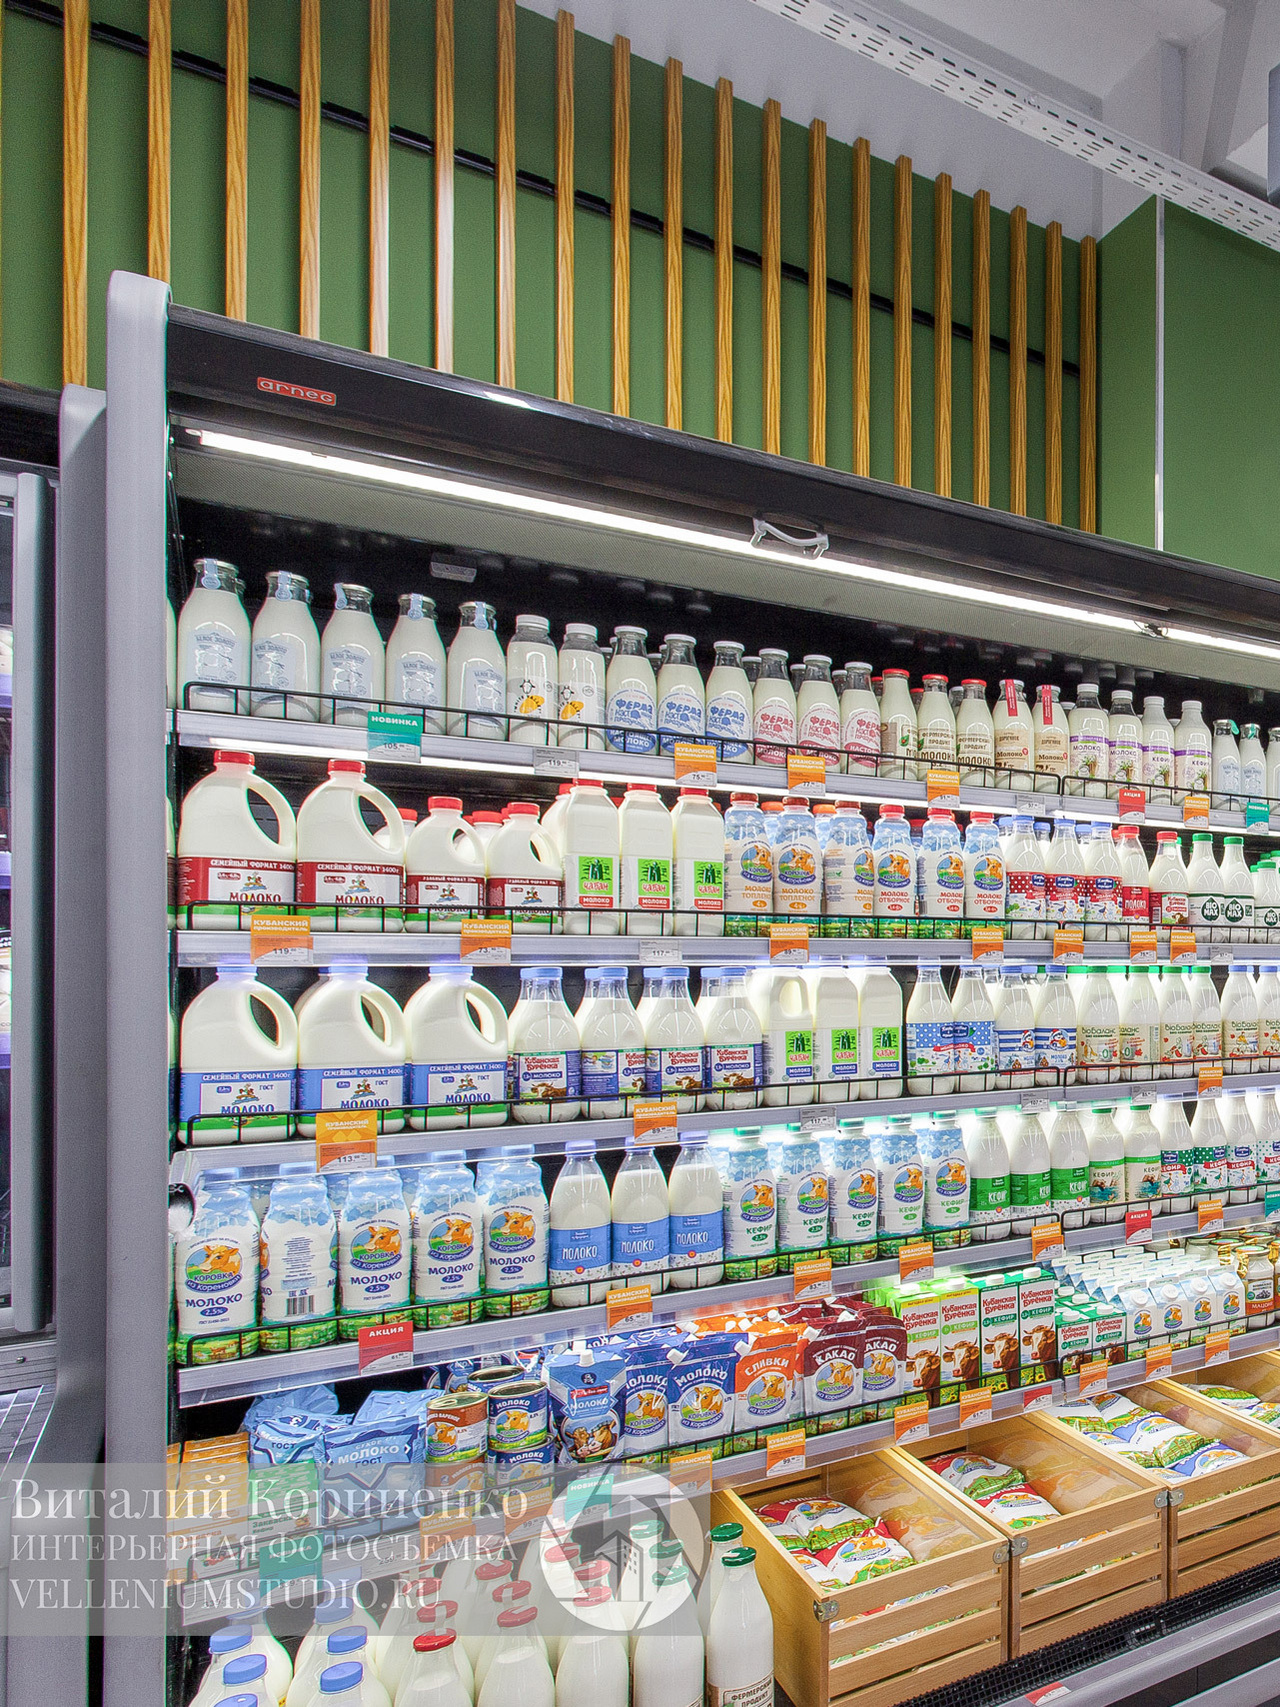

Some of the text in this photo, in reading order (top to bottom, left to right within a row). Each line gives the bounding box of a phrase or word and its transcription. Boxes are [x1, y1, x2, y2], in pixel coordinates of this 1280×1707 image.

[260, 380, 333, 403] arneg
[615, 699, 653, 713] ФЕРМА
[666, 702, 702, 716] ФЕРМА
[710, 706, 745, 721] ФЕРМА
[372, 715, 418, 726] НОВИНКА
[789, 758, 824, 766] КУБАНСКИЙ
[957, 757, 992, 765] МОЛОКО
[210, 859, 278, 870] СЕМЕЙНЫЙ ФОРМАТ
[317, 863, 352, 871] СЕМЕЙНЫЙ
[229, 892, 281, 902] МОЛОКО
[335, 894, 385, 904] МОЛОКО
[583, 897, 610, 905] МОЛОКО
[1125, 901, 1146, 909] МОЛОКО
[1205, 901, 1217, 909] BIO
[253, 919, 308, 927] КУБАНСКИЙ
[524, 1056, 560, 1064] Кубанская
[202, 1072, 240, 1081] СЕМЕЙНЫЙ
[241, 1072, 270, 1080] ФОРМАТ
[323, 1069, 358, 1077] СЕМЕЙНЫЙ
[446, 1093, 491, 1103] МОЛОКО
[340, 1098, 390, 1109] МОЛОКО
[221, 1104, 275, 1114] МОЛОКО
[636, 1105, 676, 1114] КУБАНСКИЙ
[325, 1119, 369, 1127] КУБАНСКИЙ
[1069, 1181, 1088, 1194] КЕФИР
[988, 1189, 1008, 1203] КЕФИР
[940, 1199, 965, 1207] КЕФИР
[746, 1224, 773, 1234] КЕФИР
[496, 1235, 527, 1243] КОРОВКА
[676, 1231, 709, 1245] МОЛОКО
[437, 1242, 468, 1252] КОРОВКА
[621, 1239, 655, 1253] МОЛОКО
[900, 1246, 932, 1256] КУБАНСКИЙ
[359, 1251, 396, 1261] КОРОВКА
[562, 1246, 598, 1260] МОЛОКО
[489, 1254, 535, 1266] МОЛОКО
[428, 1262, 474, 1276] МОЛОКО
[795, 1261, 831, 1271] КУБАНСКИЙ
[194, 1272, 234, 1281] КОРОВКА
[350, 1271, 402, 1285] МОЛОКО
[608, 1288, 650, 1300] КУБАНСКИЙ
[1020, 1288, 1054, 1300] Кубанская
[186, 1293, 243, 1308] МОЛОКО
[982, 1295, 1016, 1307] Кубанская
[941, 1303, 977, 1314] Кубанская
[1031, 1307, 1052, 1315] КЕФИР
[903, 1311, 939, 1323] Кубанская
[993, 1314, 1016, 1322] КЕФИР
[953, 1321, 976, 1330] КЕФИР
[1095, 1318, 1122, 1329] Кубанская
[368, 1325, 404, 1338] АКЦИЯ
[913, 1330, 937, 1338] КЕФИР
[1061, 1325, 1089, 1335] Кубанская
[1103, 1332, 1121, 1340] КЕФИР
[1069, 1338, 1088, 1346] КЕФИР
[816, 1349, 856, 1365] КАКАО
[744, 1356, 789, 1376] СЛИВКИ
[676, 1367, 728, 1387] МОЛОКО
[822, 1383, 851, 1393] КОРОВКА
[961, 1391, 991, 1402] КУБАНСКИЙ
[496, 1399, 531, 1409] МОЛОКО
[755, 1397, 784, 1408] КОРОВКА
[688, 1411, 717, 1420] КОРОВКА
[896, 1405, 928, 1416] КУБАНСКИЙ
[768, 1431, 805, 1448] КУБАНСКИЙ
[271, 1442, 295, 1450] ГОСТ
[337, 1445, 400, 1463] МОЛОКО
[508, 1451, 545, 1463] МОЛОКО
